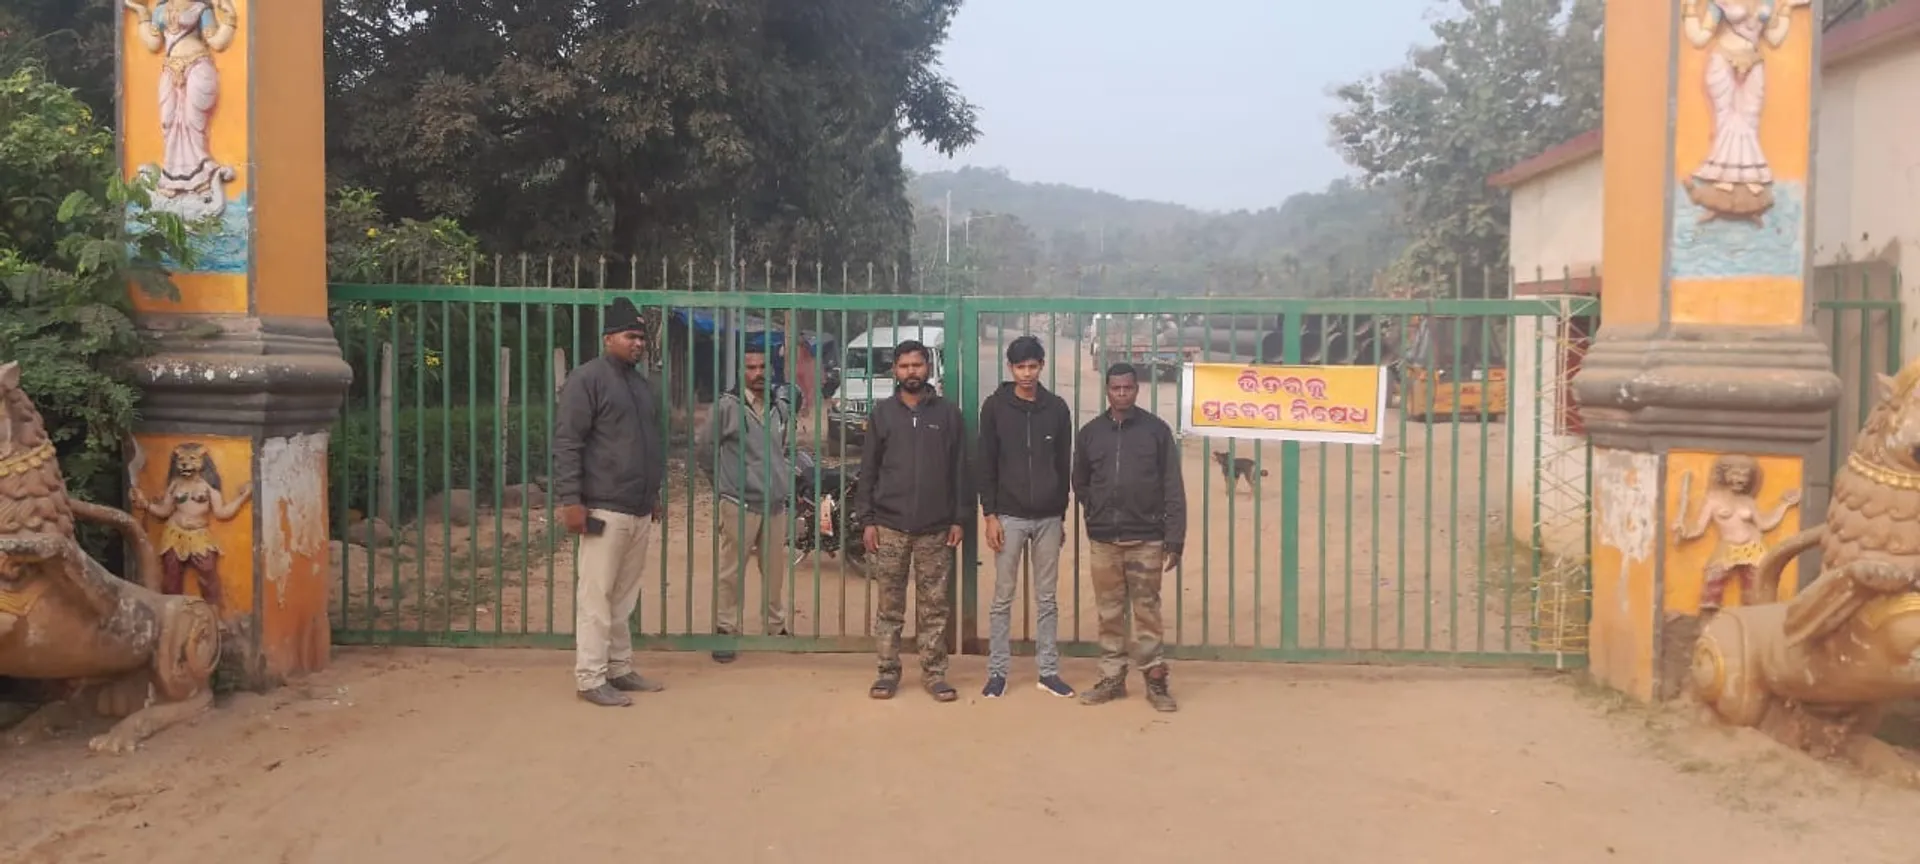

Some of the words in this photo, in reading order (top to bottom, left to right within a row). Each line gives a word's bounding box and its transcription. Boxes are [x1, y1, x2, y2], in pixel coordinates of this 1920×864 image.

[1238, 370, 1326, 398] ଭିତରକୁ
[1201, 400, 1281, 421] ପ୍ରବେଶ
[1291, 398, 1368, 422] ନିଷେଧ
